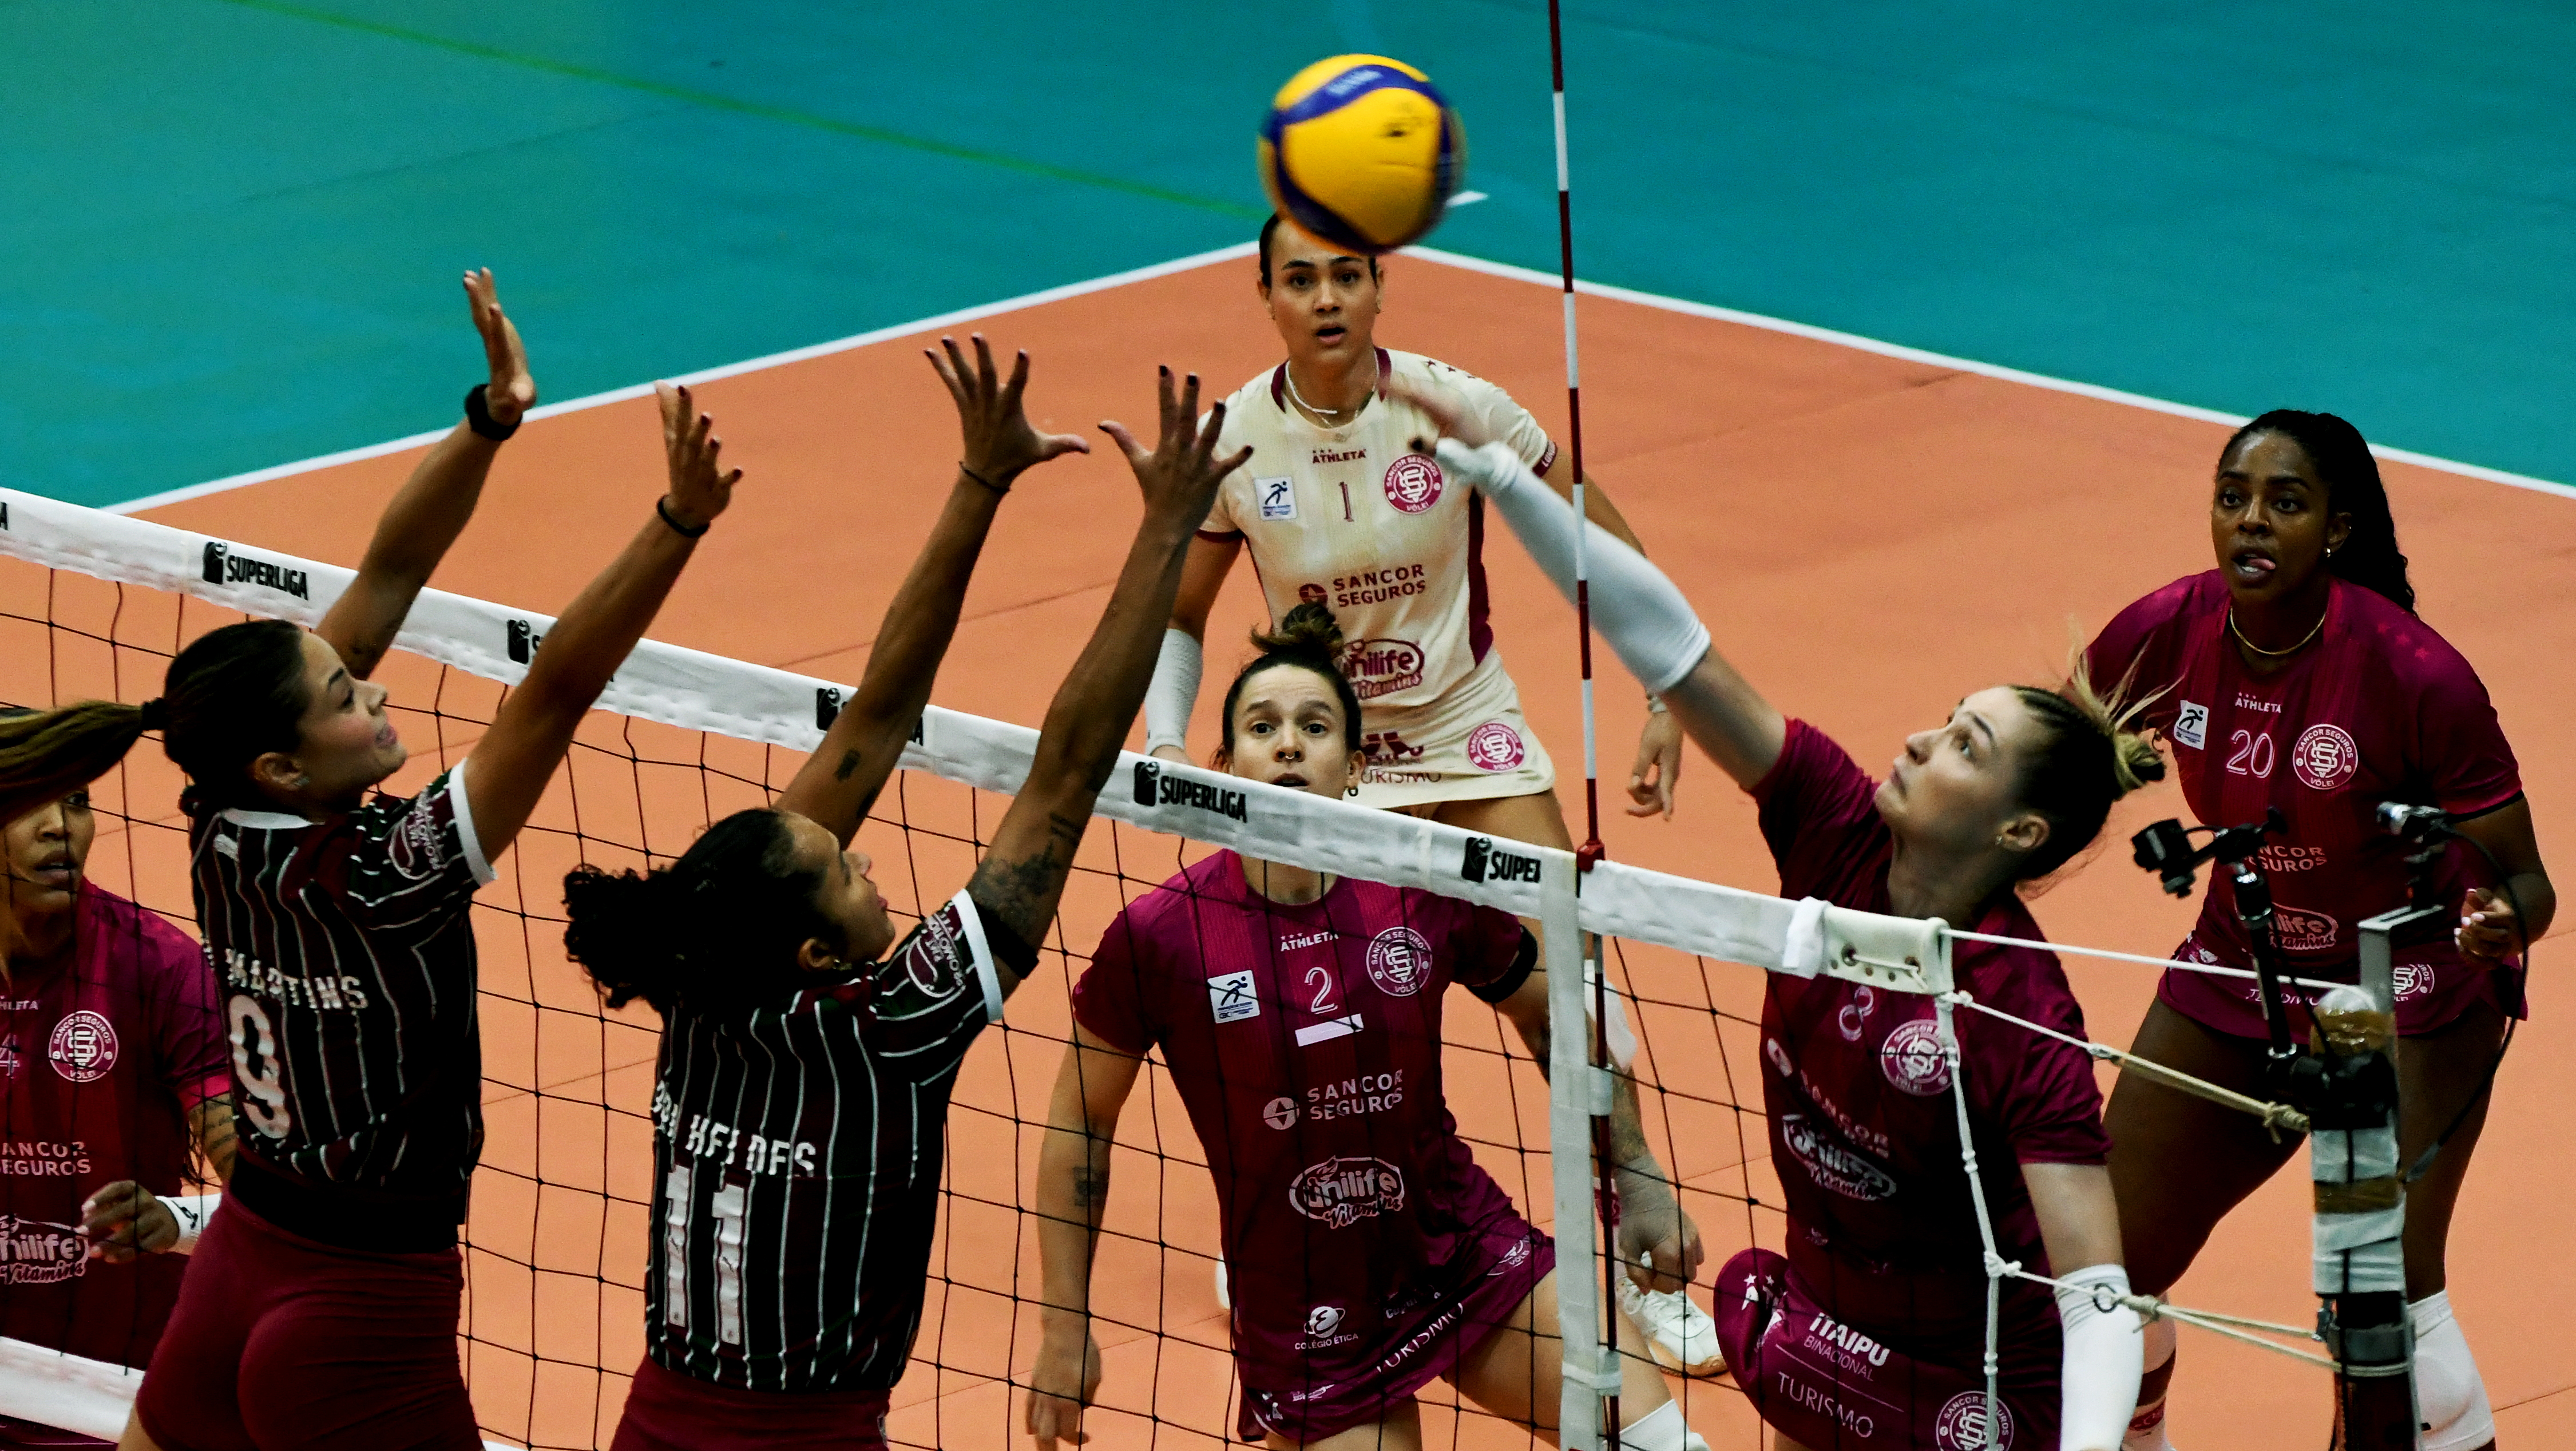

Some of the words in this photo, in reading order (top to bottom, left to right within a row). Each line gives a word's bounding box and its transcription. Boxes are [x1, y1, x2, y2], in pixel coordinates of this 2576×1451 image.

[1312, 449, 1366, 464] ATHLETA
[1338, 481, 1354, 522] 1
[227, 554, 308, 601] SUPERLIGA
[1333, 564, 1424, 592] SANCOR
[1337, 580, 1426, 608] SEGUROS
[1345, 649, 1414, 678] nilife
[2235, 697, 2281, 713] ATHLETA
[2226, 729, 2275, 779] 20
[2298, 728, 2324, 752] SANCOR
[2325, 729, 2353, 758] SEGUROS
[1159, 775, 1247, 824] SUPERLIGA
[1489, 851, 1541, 883] SUPE
[2258, 845, 2325, 858] NCOR
[1281, 931, 1339, 952] ATHLETA
[0, 1000, 38, 1010] HLETA
[1304, 966, 1338, 1014] 2
[229, 994, 291, 1140] 9
[1306, 1068, 1402, 1103] SANCOR
[1310, 1087, 1402, 1120] SEGUROS
[2, 1141, 88, 1157] ANCOR
[0, 1159, 92, 1176] EGUROS
[1303, 1168, 1398, 1208] unilife
[0, 1234, 80, 1261] nilife
[665, 1164, 744, 1346] 11
[1295, 1338, 1333, 1350] COLÉGIO
[1334, 1333, 1359, 1345] ÉTICA
[1808, 1312, 1891, 1367] ITAIPU
[1804, 1335, 1874, 1382] BINACIONAL
[1778, 1371, 1874, 1438] TURISMO
[1944, 1396, 1979, 1419] SANCOR
